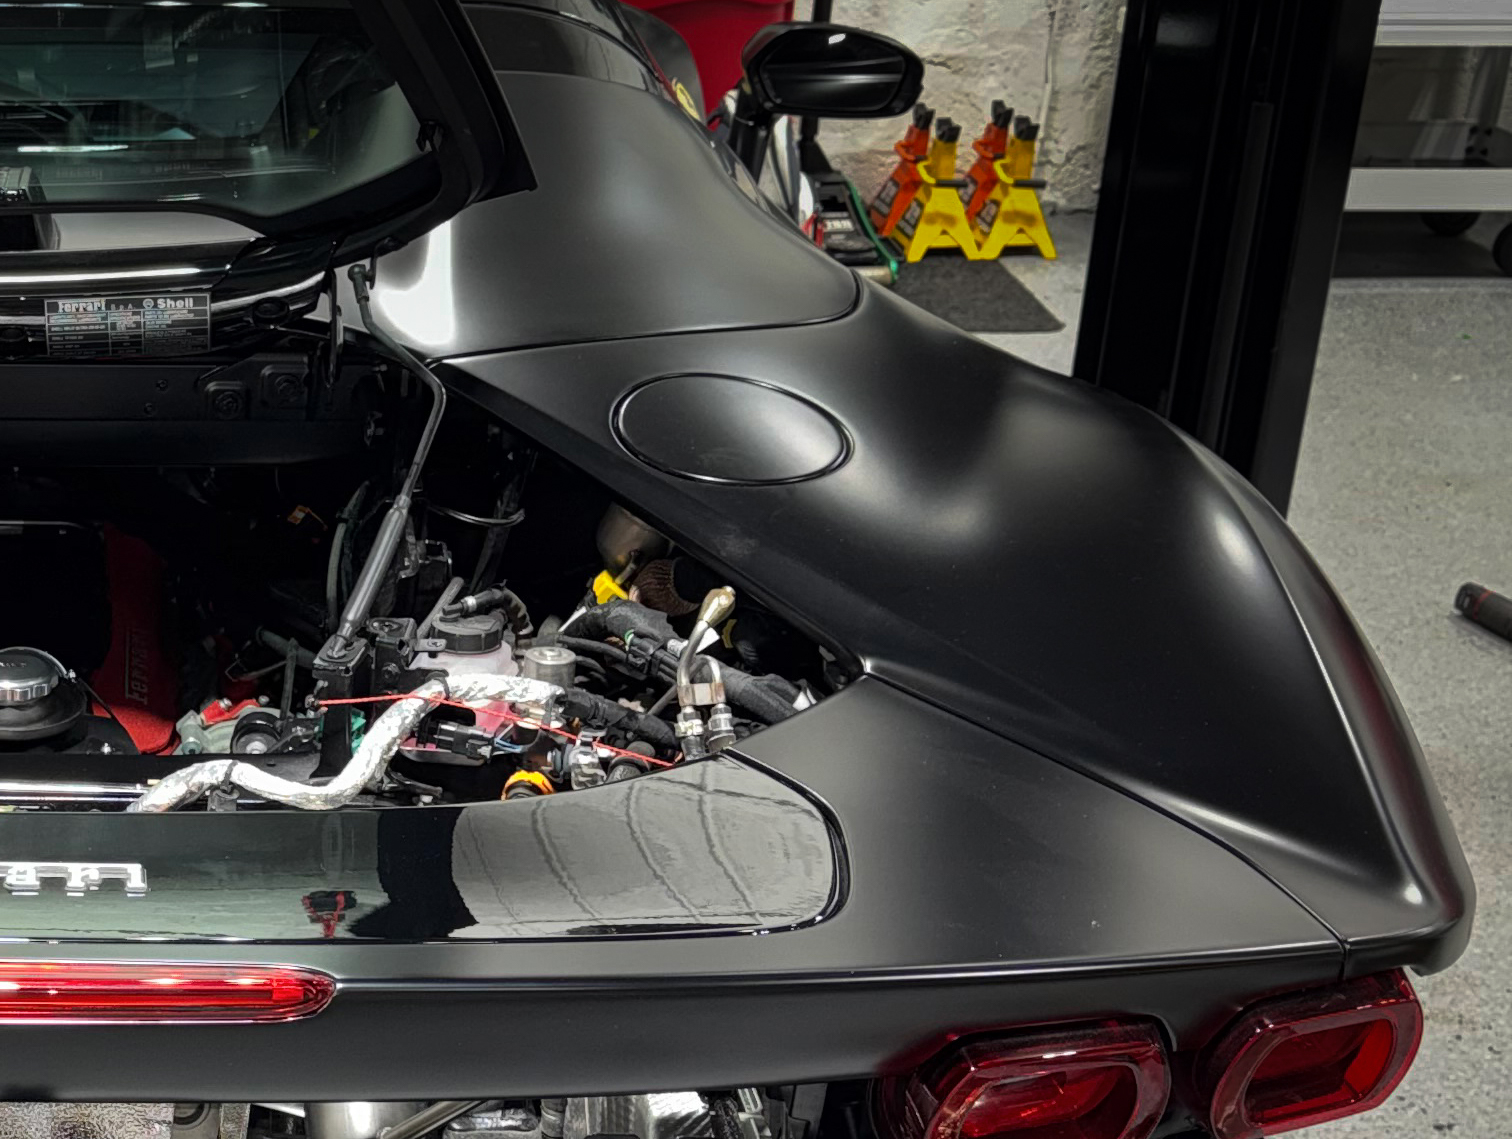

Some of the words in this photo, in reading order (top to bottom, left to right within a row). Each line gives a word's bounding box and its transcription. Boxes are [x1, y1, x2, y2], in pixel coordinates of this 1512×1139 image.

[57, 299, 106, 313] Ferrari
[157, 298, 194, 309] Shell
[124, 627, 148, 705] Ferrari
